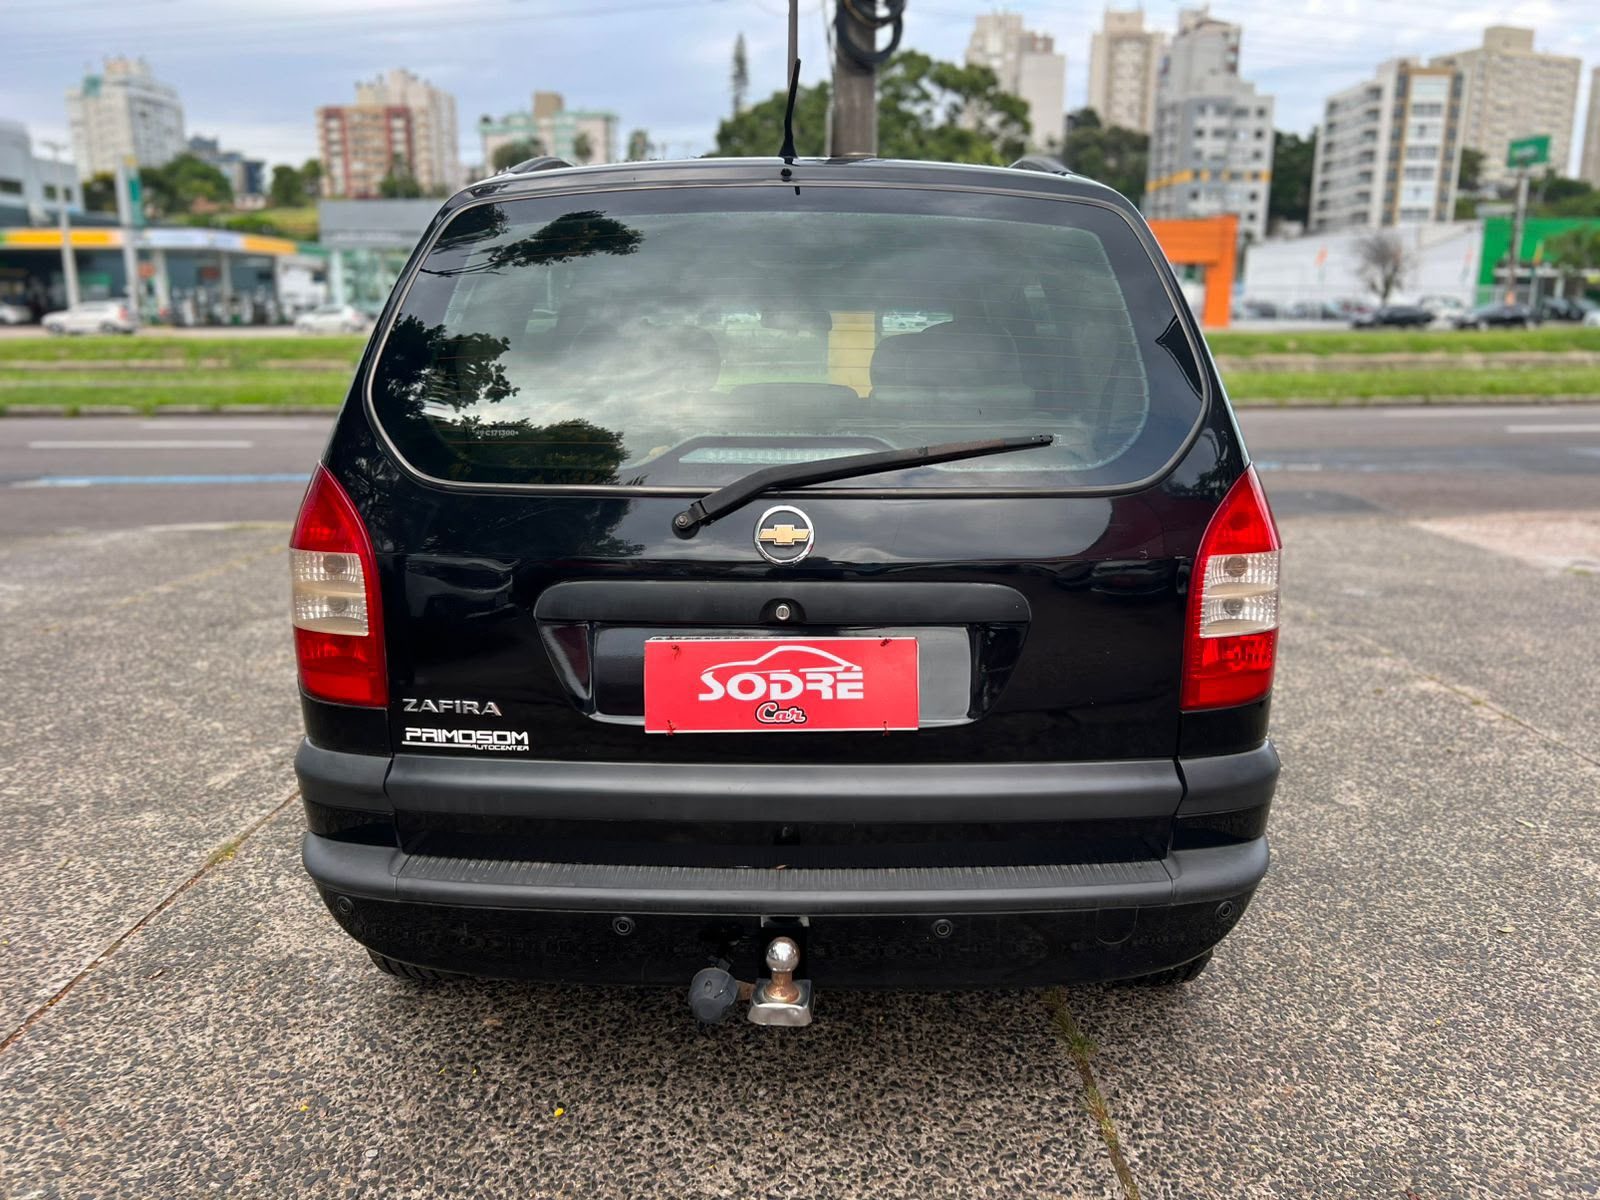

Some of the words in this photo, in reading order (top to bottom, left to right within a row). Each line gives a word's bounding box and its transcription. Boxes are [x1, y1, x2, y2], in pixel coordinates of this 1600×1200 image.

[402, 698, 502, 716] ZAFIRA
[755, 701, 807, 724] Car
[405, 727, 529, 745] PRIMOSOM
[472, 744, 529, 752] AUTOCENTER
